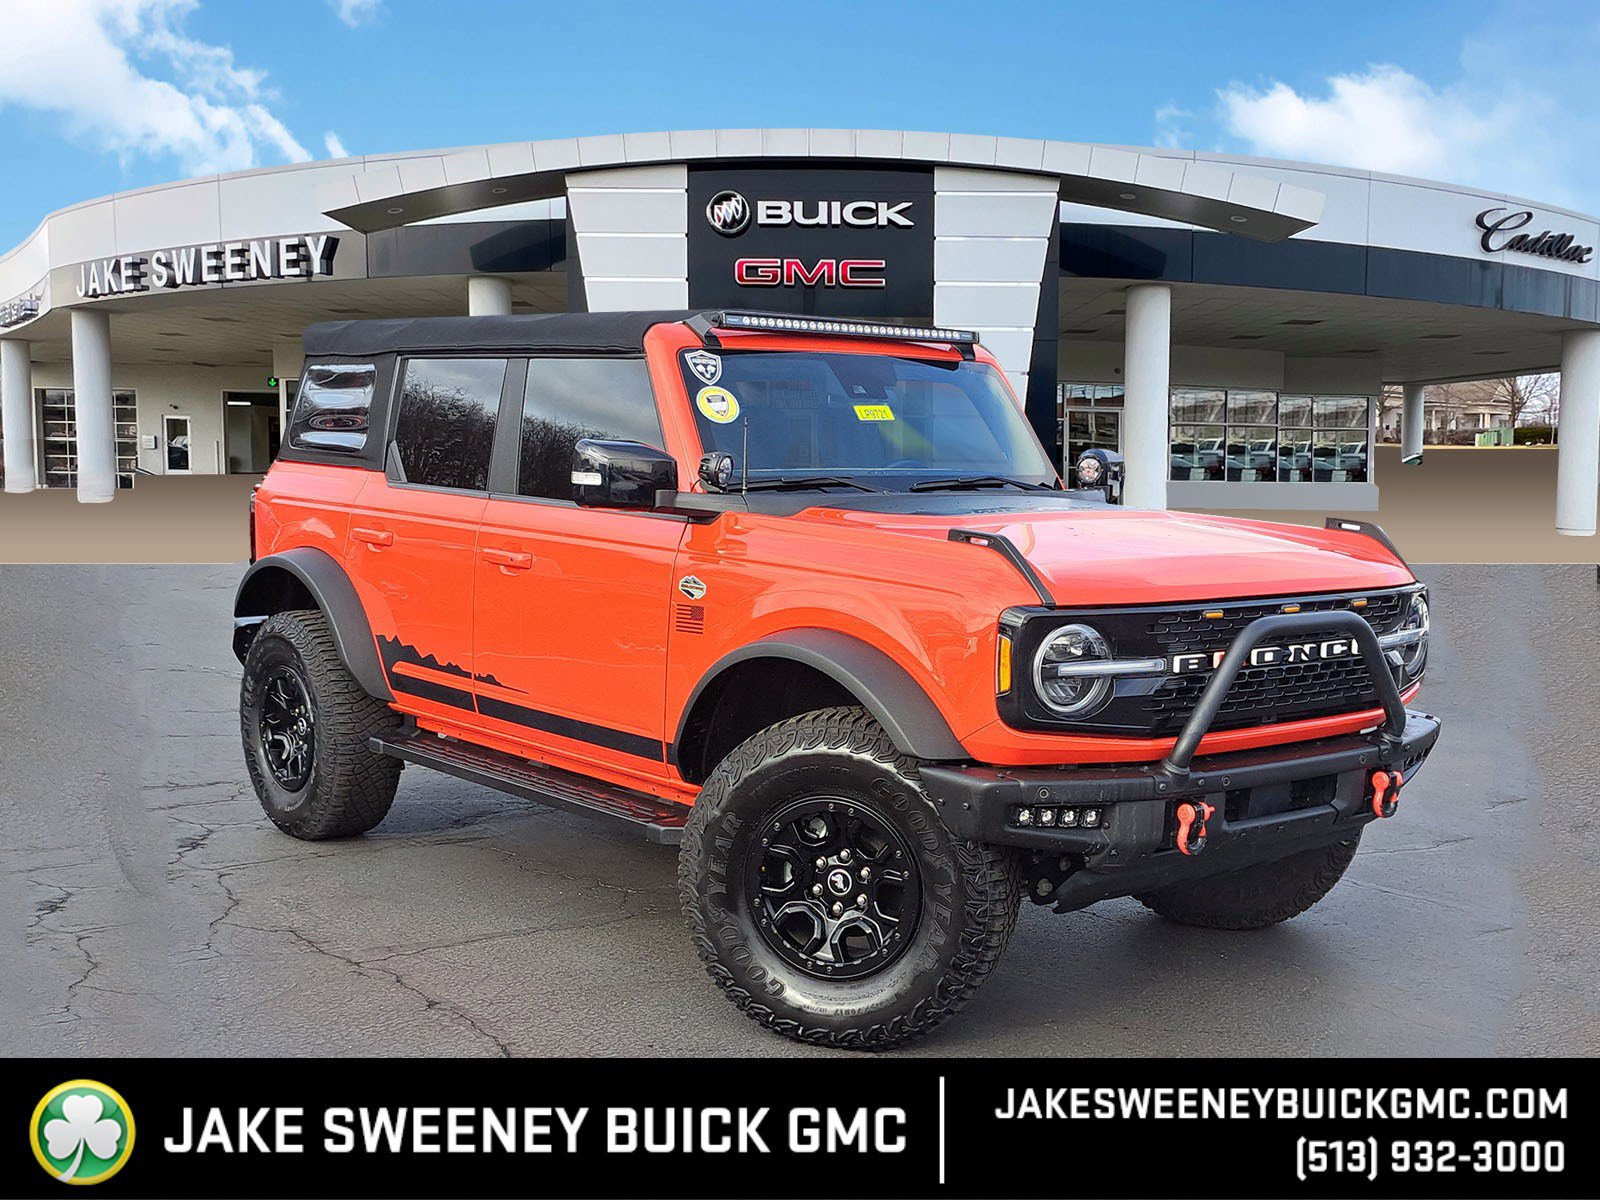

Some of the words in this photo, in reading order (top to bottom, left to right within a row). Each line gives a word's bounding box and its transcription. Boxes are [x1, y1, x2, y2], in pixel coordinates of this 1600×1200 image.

[757, 201, 914, 227] BUICK
[1475, 207, 1594, 264] Cadillac
[76, 256, 141, 298] JAKE
[151, 234, 334, 289] SWEENEY
[734, 258, 886, 287] GMC
[1172, 638, 1359, 674] BONC
[871, 777, 956, 971] GOODYEAR
[705, 811, 787, 999] GOODYEAR
